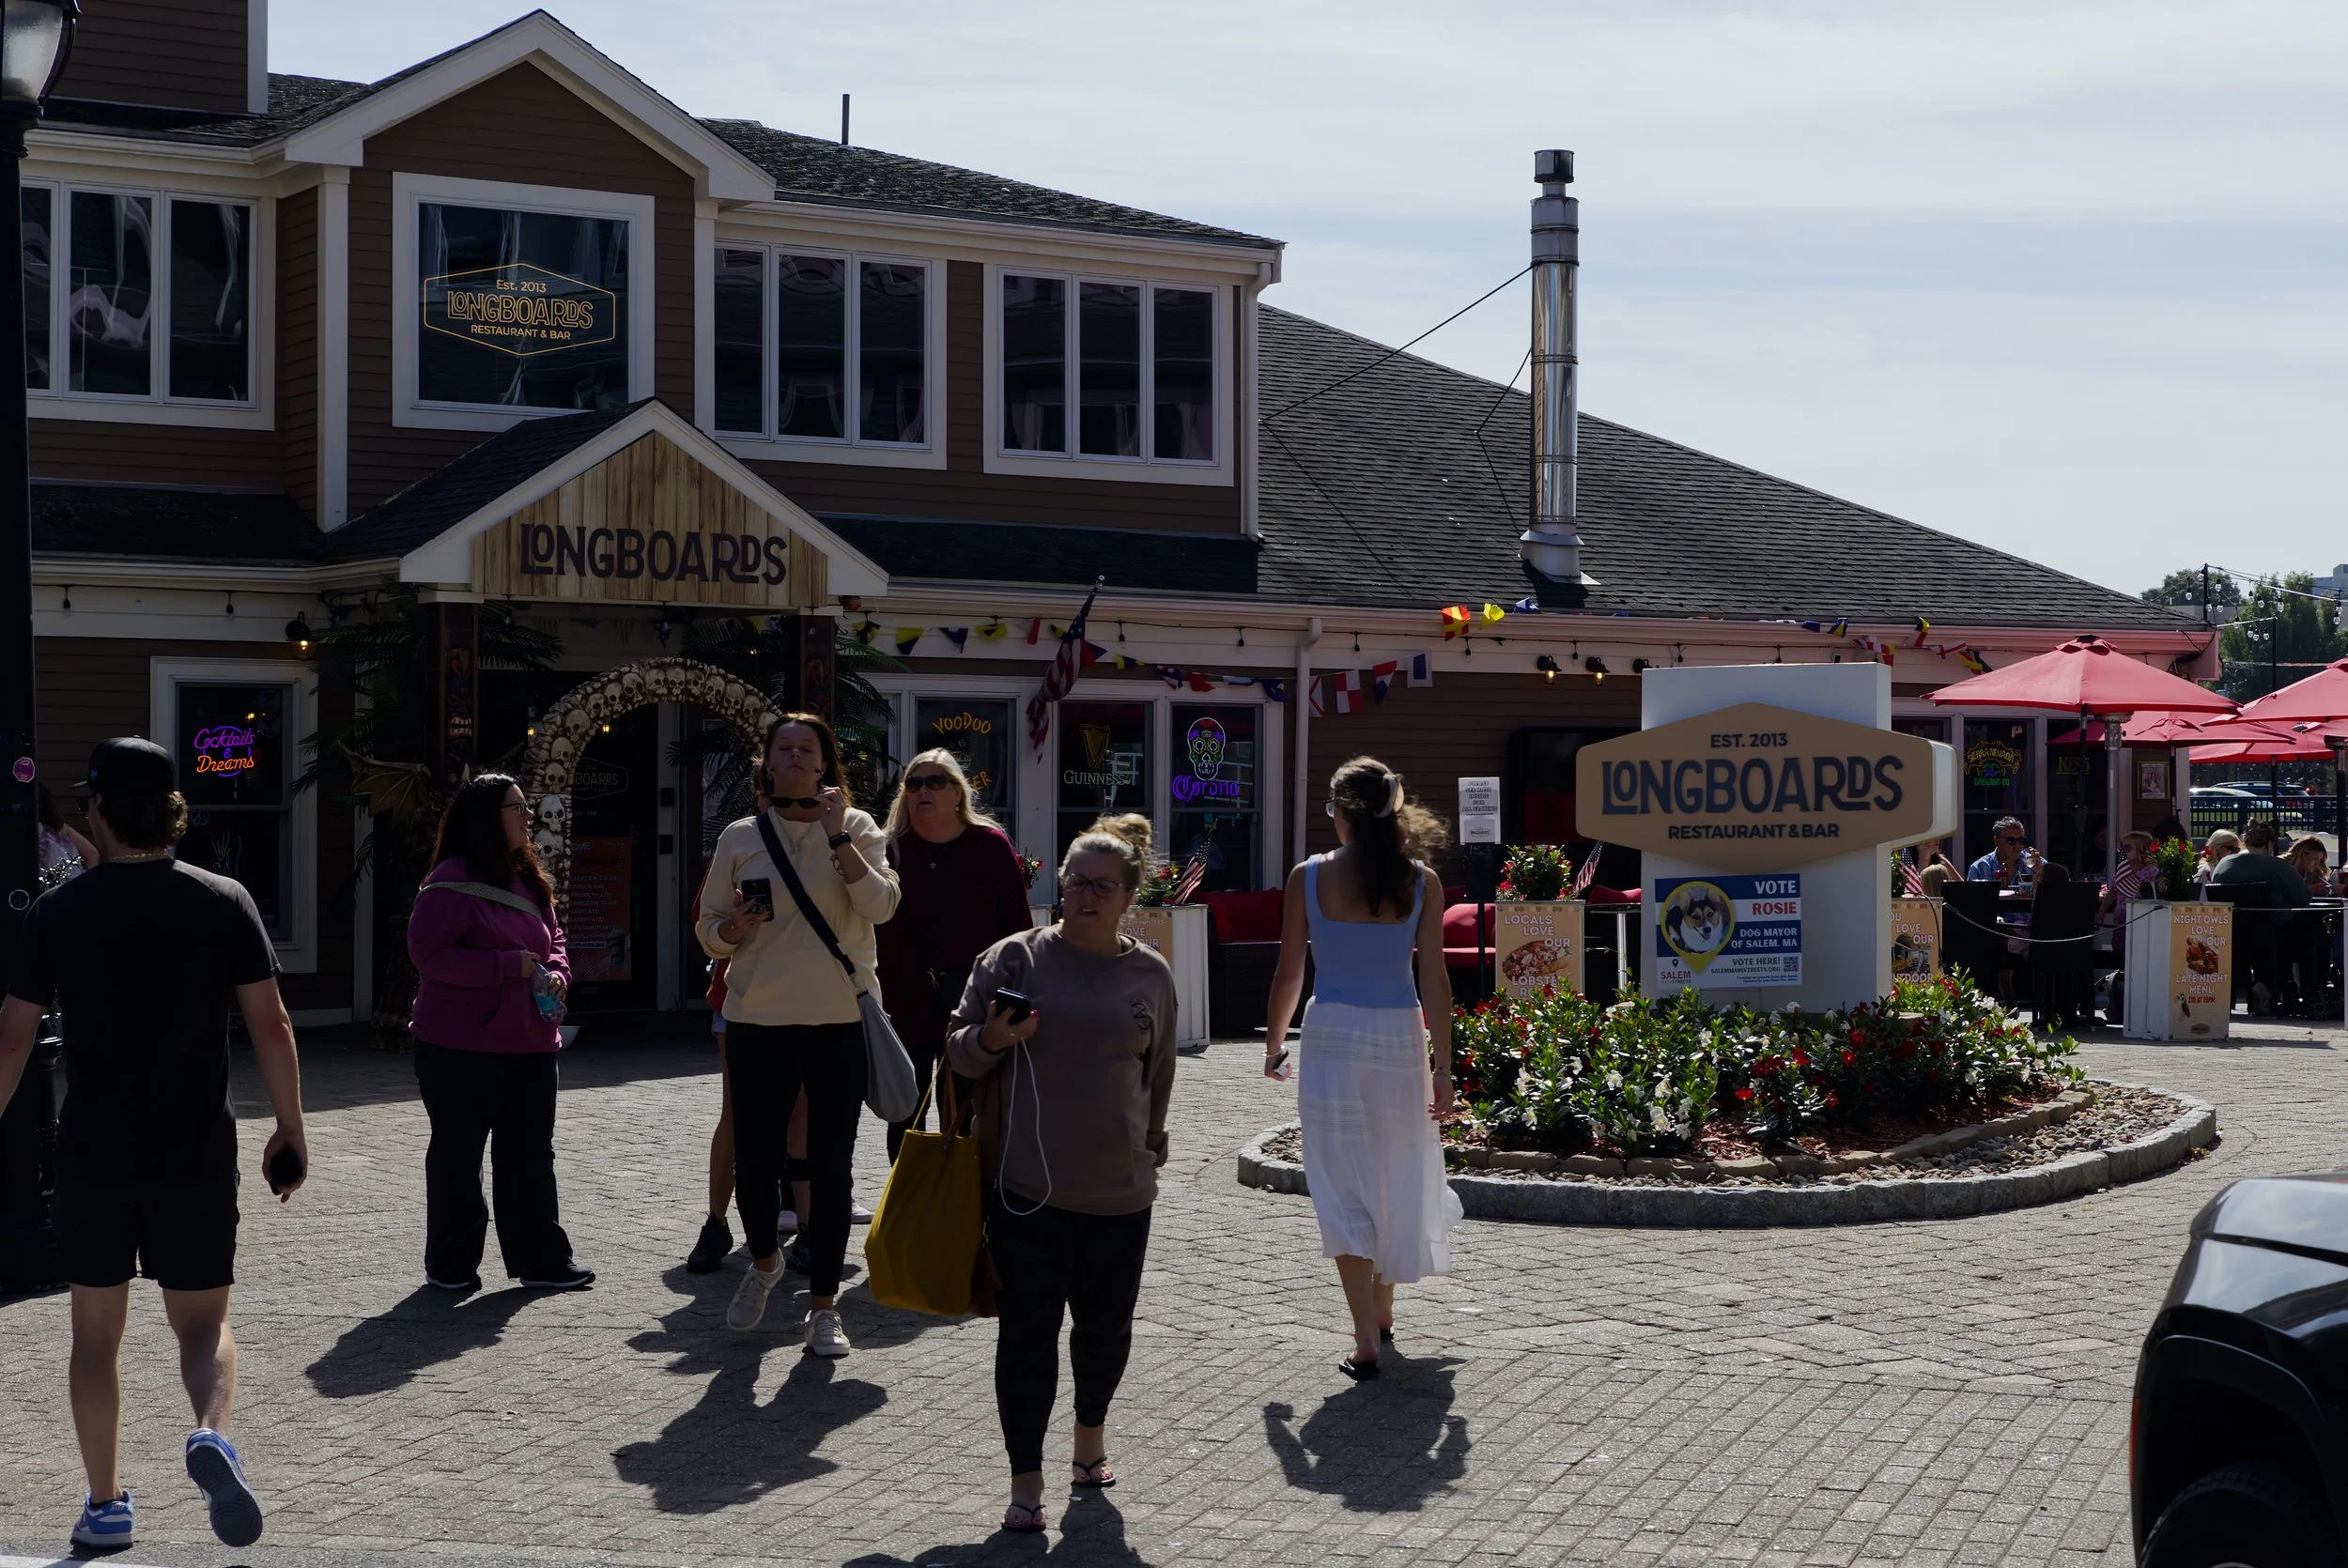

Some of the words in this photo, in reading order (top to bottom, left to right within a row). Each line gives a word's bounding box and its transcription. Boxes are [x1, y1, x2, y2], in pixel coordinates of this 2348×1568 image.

[520, 281, 547, 293] 2013
[447, 290, 594, 330] LONGBOARDS
[471, 324, 538, 337] RESTAURANT
[540, 330, 548, 339] &
[550, 330, 571, 340] BAR
[520, 523, 787, 585] LONGBOARDS
[933, 711, 992, 735] VOODOO
[193, 728, 255, 749] Cocktails
[1710, 733, 1745, 748] EST.
[1750, 732, 1788, 747] 2013
[196, 755, 255, 773] Dreams
[1063, 769, 1126, 786] GUINNESS
[1172, 774, 1240, 805] Corona
[1601, 755, 1904, 815] LONGBOARDS
[1801, 823, 1839, 838] BAR
[1753, 880, 1797, 895] VOTE
[1752, 901, 1797, 915] ROSIE
[1505, 915, 1552, 925] LOCALS
[1892, 912, 1902, 922] OU
[2173, 915, 2201, 924] NIGHT
[2203, 915, 2229, 925] OWLS
[1523, 926, 1554, 936] LOVE
[1739, 928, 1761, 938] DOG
[1763, 927, 1798, 937] MAYOR
[1896, 923, 1921, 933] LOVE
[2191, 925, 2215, 935] LOVE
[1544, 938, 1571, 947] OUR
[1731, 940, 1743, 948] OF
[1782, 938, 1798, 947] MA
[1913, 934, 1934, 945] OUR
[2206, 937, 2226, 946] OUR
[1732, 958, 1753, 966] VOTE
[1755, 957, 1781, 965] HERE!
[1660, 971, 1691, 979] SALEM
[1892, 973, 1933, 983] UTDOOR
[2176, 974, 2198, 983] LATE
[2199, 974, 2229, 983] NIGHT
[1511, 976, 1558, 986] LOBSTE
[2189, 985, 2215, 994] MENU
